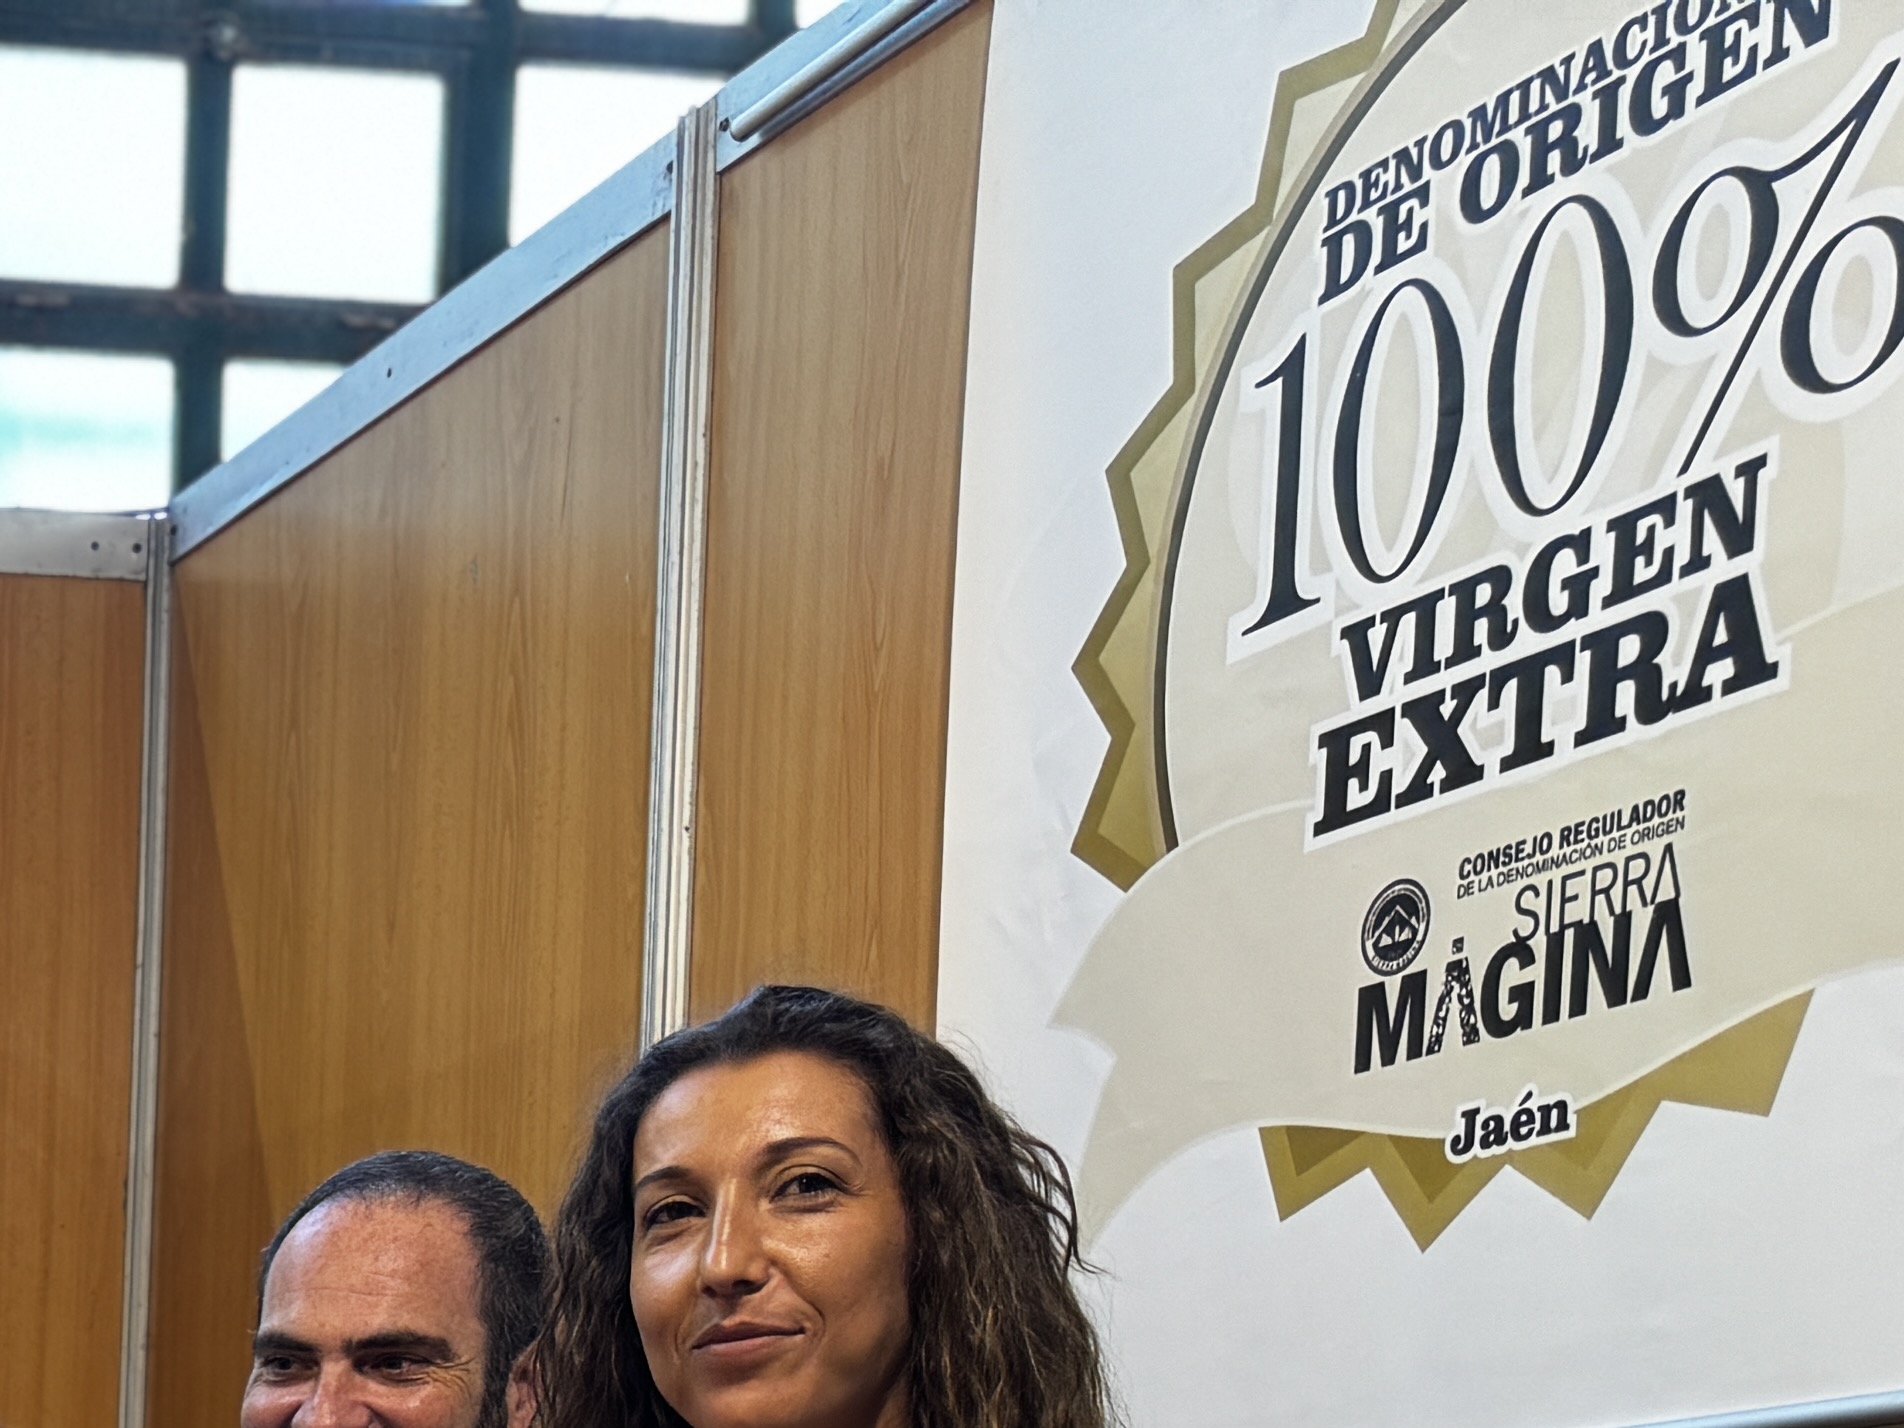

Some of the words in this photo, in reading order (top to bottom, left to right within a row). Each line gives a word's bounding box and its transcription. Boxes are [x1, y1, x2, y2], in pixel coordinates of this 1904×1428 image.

[1319, 183, 1430, 306] DE
[1459, 0, 1833, 224] ORIGEN
[1322, 0, 1754, 231] DENOMINACIO
[1242, 57, 1904, 636] 100%
[1339, 454, 1769, 702] VIRGEN
[1313, 573, 1779, 838] EXTRA
[1456, 883, 1475, 900] DE
[1478, 876, 1495, 893] LA
[1496, 840, 1604, 887] DENOMINACIÓN
[1607, 835, 1627, 853] DE
[1630, 815, 1686, 846] ORIGEN
[1457, 831, 1554, 881] CONSEJO
[1558, 788, 1686, 850] REGULADOR
[1512, 842, 1682, 942] SIERRA
[1450, 1089, 1573, 1160] Jaén
